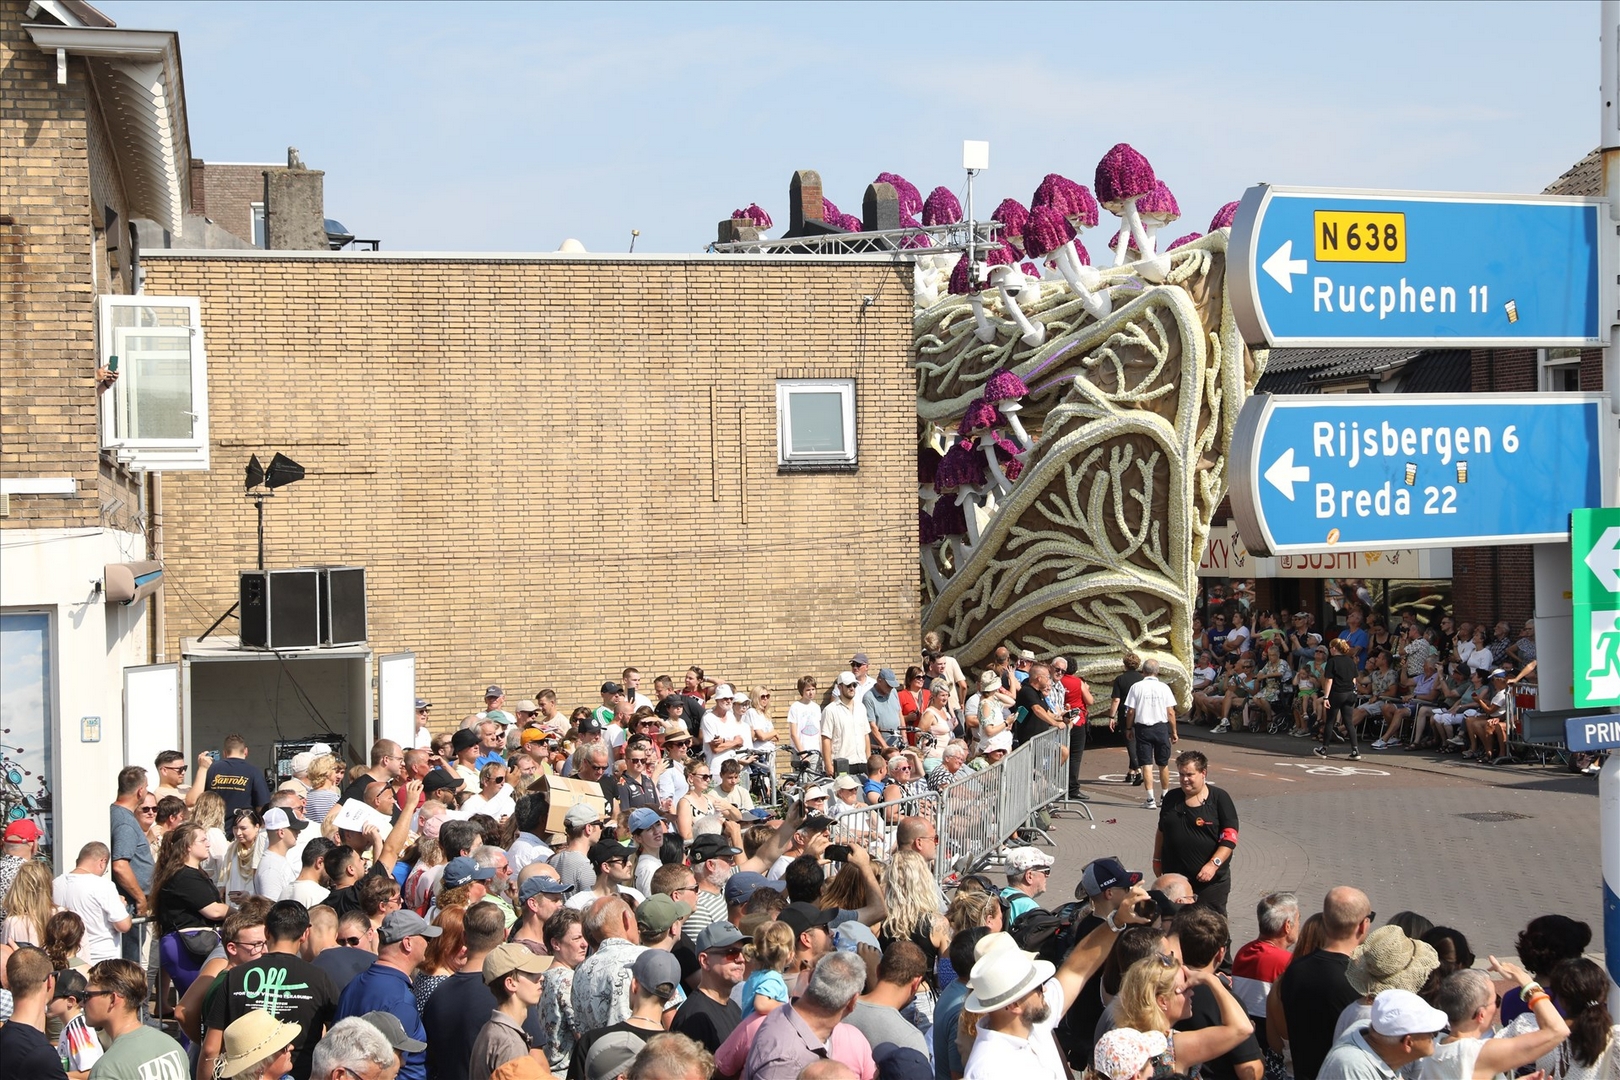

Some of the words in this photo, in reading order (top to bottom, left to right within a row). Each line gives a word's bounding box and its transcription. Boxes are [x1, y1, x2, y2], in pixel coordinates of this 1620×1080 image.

[1313, 276, 1456, 320] Rucphen
[1468, 285, 1488, 313] 11
[1313, 420, 1491, 468] Rijsbergen
[1502, 425, 1519, 453] 6
[1315, 480, 1410, 519] Breda
[1423, 485, 1457, 514] 22
